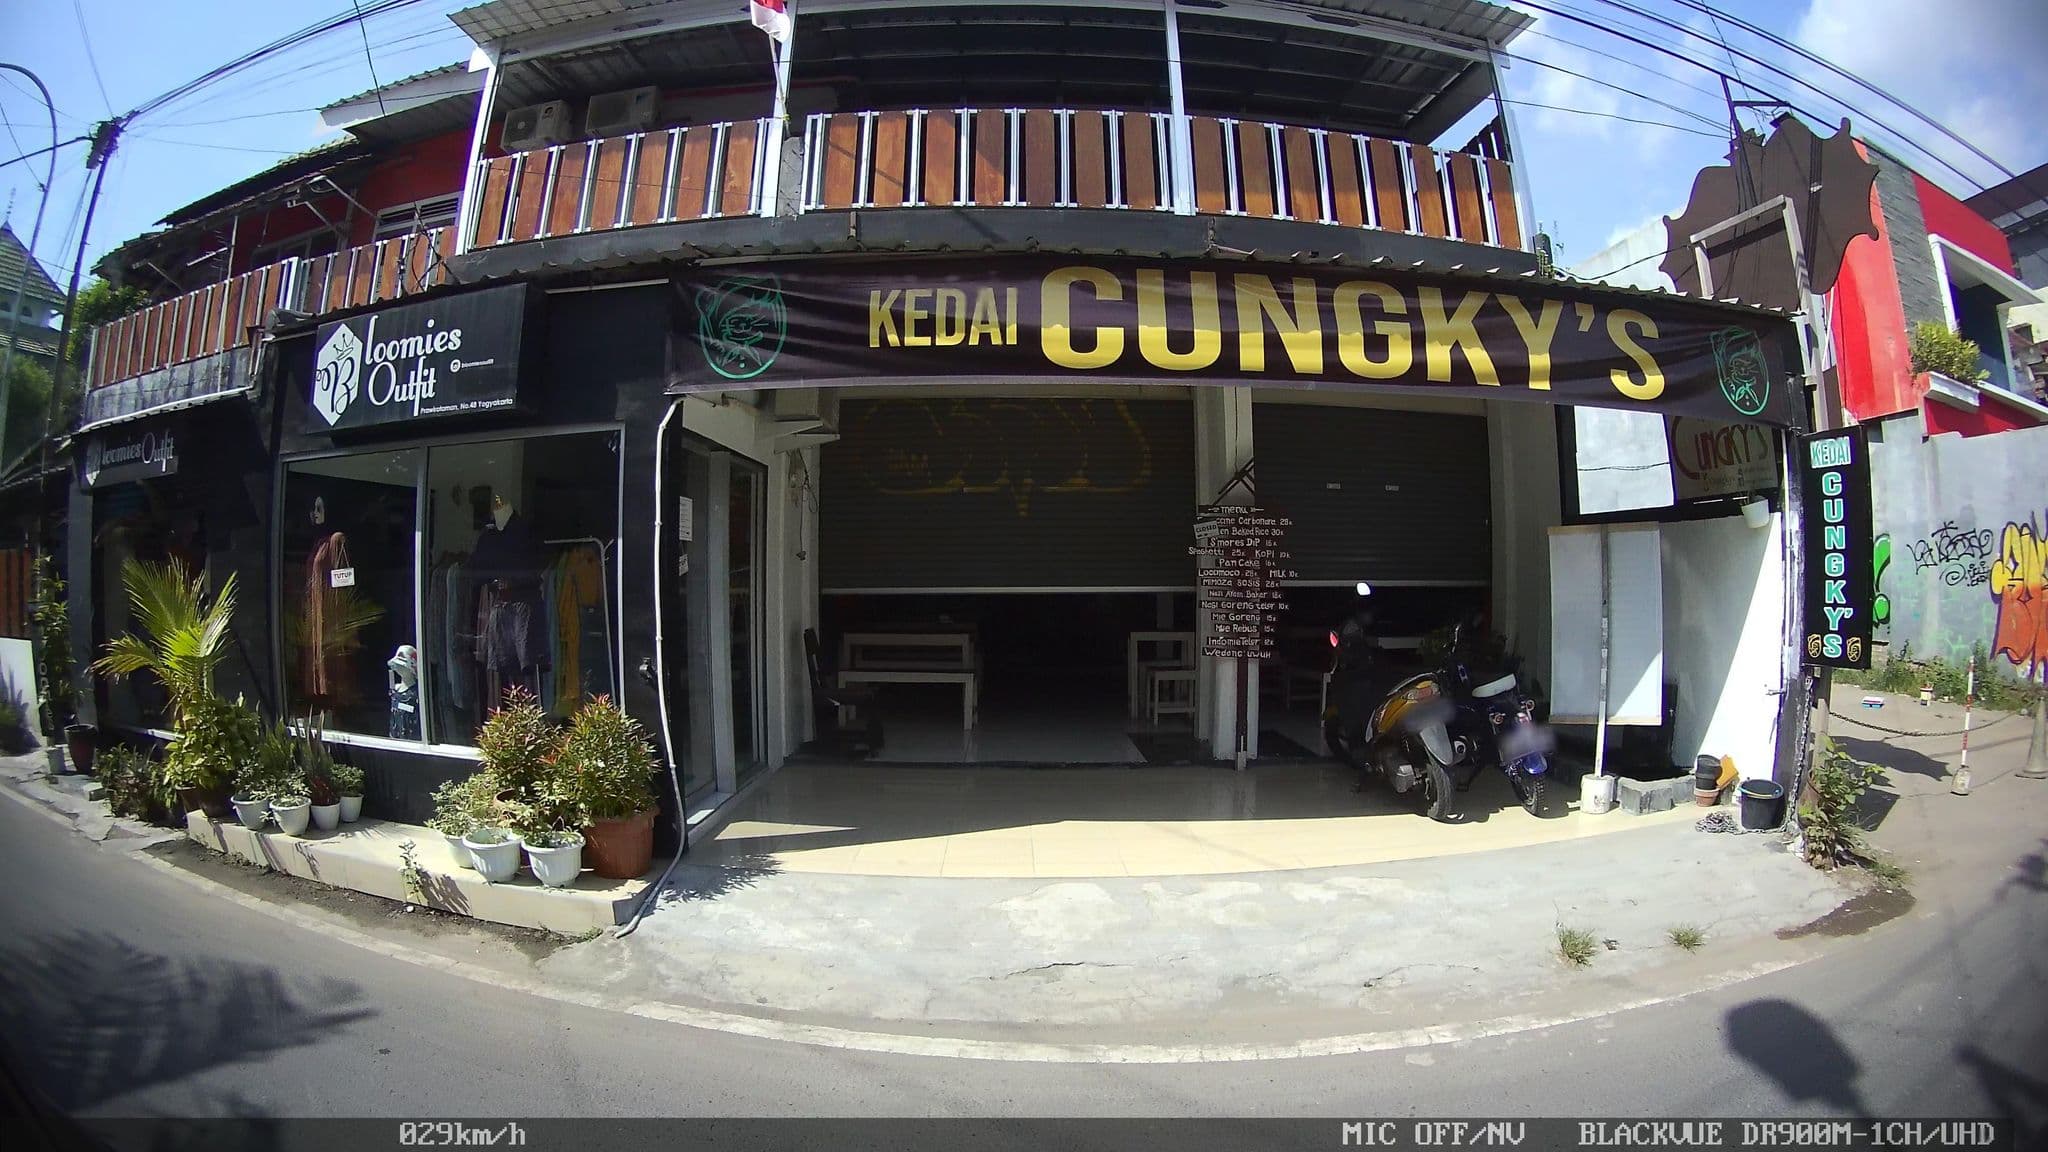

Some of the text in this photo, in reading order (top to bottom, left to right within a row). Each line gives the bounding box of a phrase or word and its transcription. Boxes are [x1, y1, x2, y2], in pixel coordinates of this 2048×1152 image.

[869, 266, 1665, 401] KEDAI CUNGKY'S
[368, 355, 436, 416] Outfit
[1810, 437, 1852, 469] KEDAI
[1821, 471, 1854, 659] CUNGKY'S
